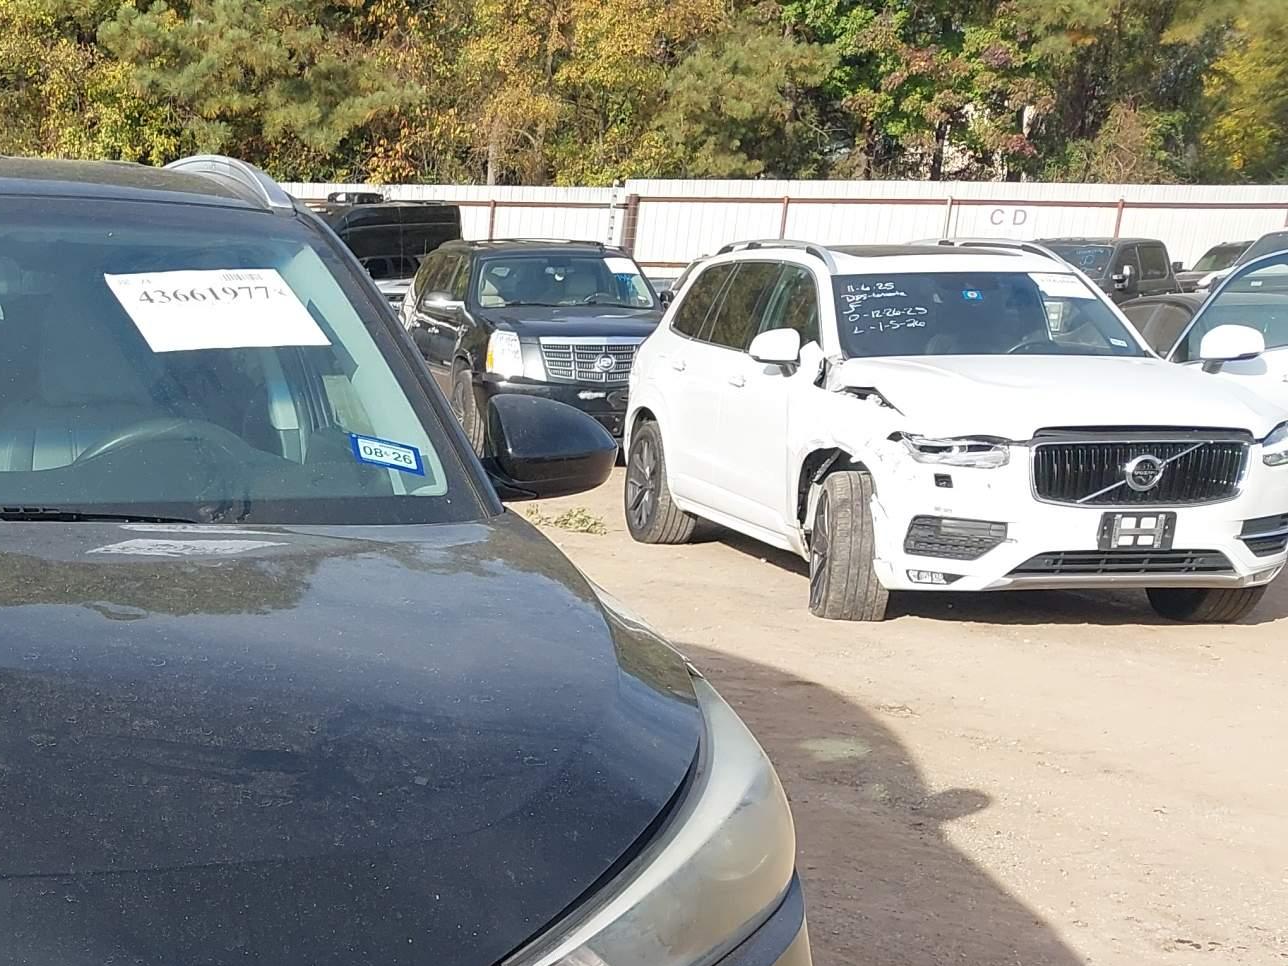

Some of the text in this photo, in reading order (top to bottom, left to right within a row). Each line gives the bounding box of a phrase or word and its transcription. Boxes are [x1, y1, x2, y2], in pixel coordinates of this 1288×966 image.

[138, 286, 270, 304] 43661977
[363, 445, 413, 464] 08 26
